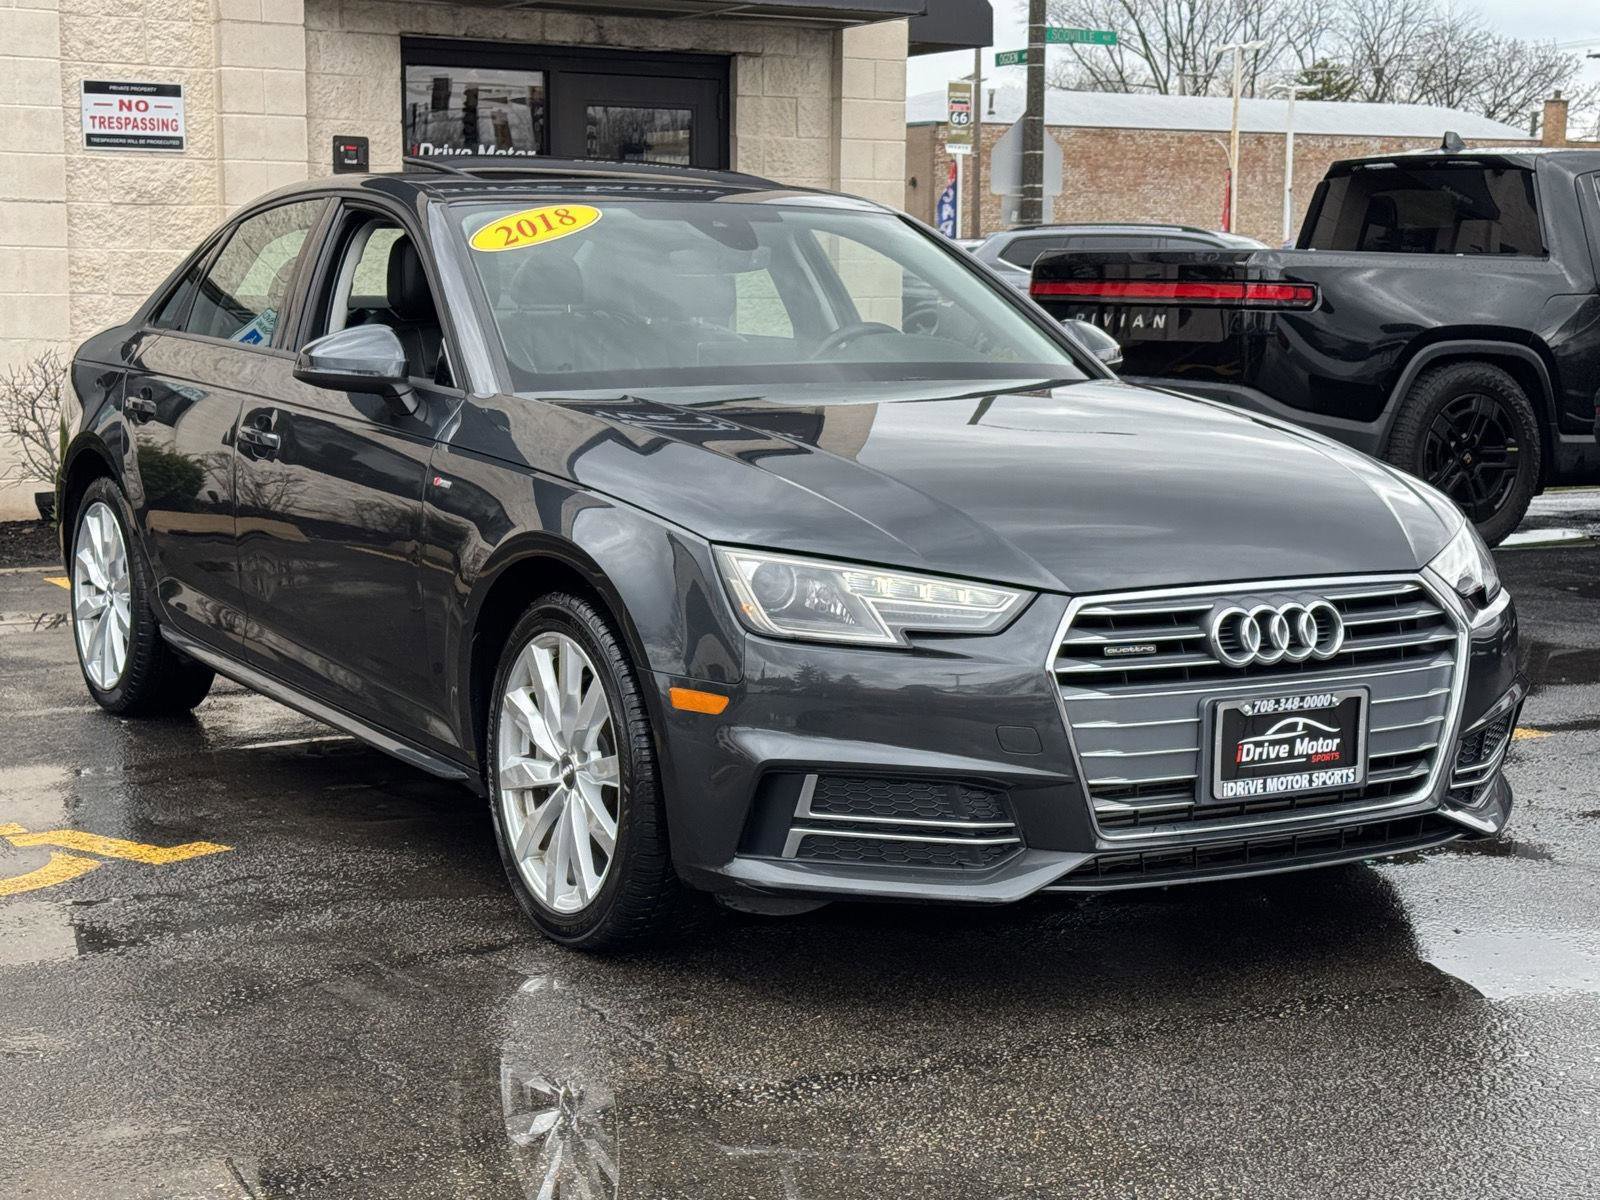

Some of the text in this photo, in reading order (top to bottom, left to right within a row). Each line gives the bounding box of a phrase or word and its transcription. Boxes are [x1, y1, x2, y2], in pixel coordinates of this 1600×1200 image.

[1052, 29, 1095, 41] SCOVILLE
[1000, 52, 1018, 65] OGDEN
[118, 98, 149, 112] NO
[89, 115, 179, 132] TRESPASSING
[952, 112, 968, 124] 66
[494, 208, 577, 246] 2018
[1106, 645, 1155, 654] quattro
[1253, 693, 1331, 713] 708-348-0000
[1235, 737, 1341, 764] iDrive Motor
[1311, 751, 1341, 763] SPORTS
[1222, 768, 1356, 797] iDRIVE MOTOR SPORTS
